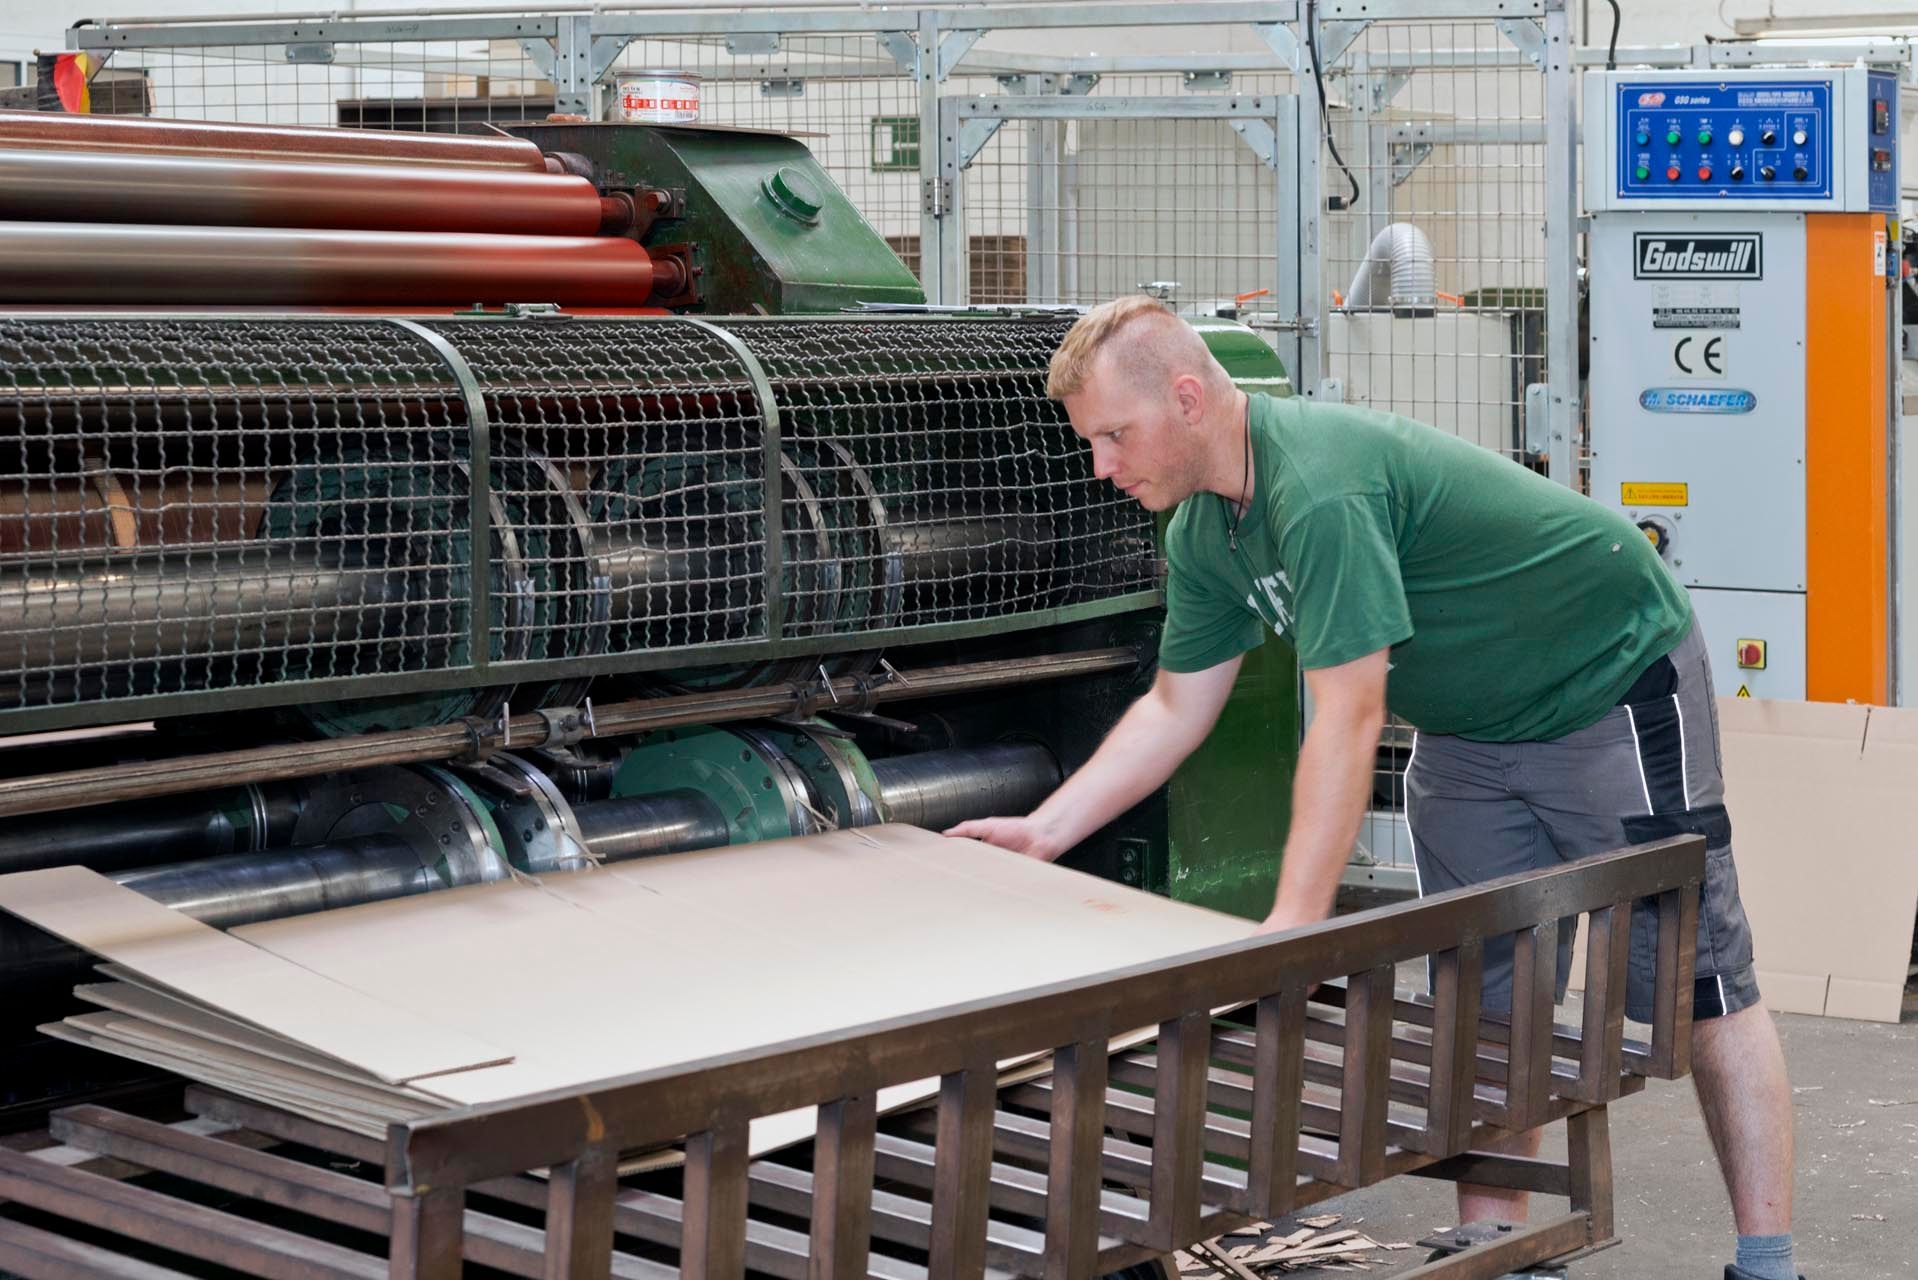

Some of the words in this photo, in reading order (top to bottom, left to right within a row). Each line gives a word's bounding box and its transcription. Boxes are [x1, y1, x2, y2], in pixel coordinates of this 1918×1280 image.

[1643, 241, 1753, 271] Godswill
[1674, 336, 1722, 375] CE
[1666, 393, 1747, 407] SCHAEFER
